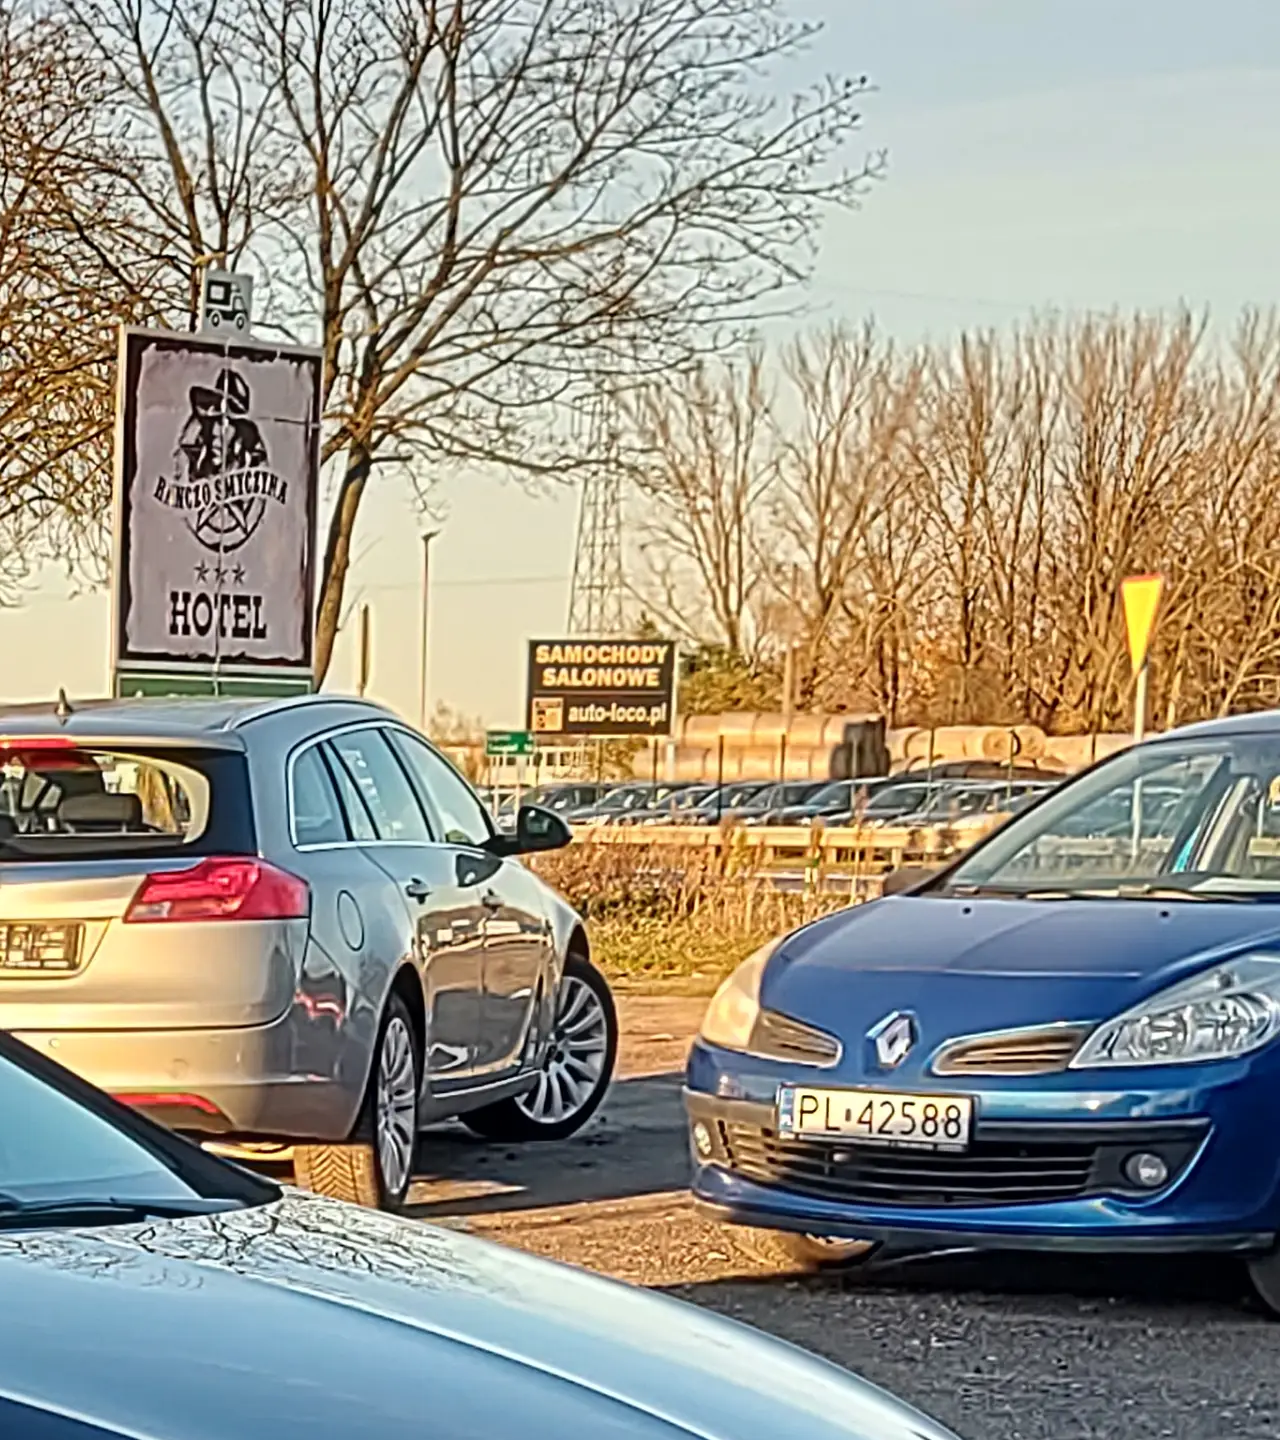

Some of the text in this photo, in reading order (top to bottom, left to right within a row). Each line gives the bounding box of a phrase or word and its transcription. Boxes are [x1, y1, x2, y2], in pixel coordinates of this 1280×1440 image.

[169, 591, 267, 639] HOTEL
[536, 645, 669, 664] SAMOCHODY
[542, 667, 660, 687] SALONOWE
[568, 703, 667, 727] auto-loco.pl
[799, 1094, 961, 1138] PL 42588
